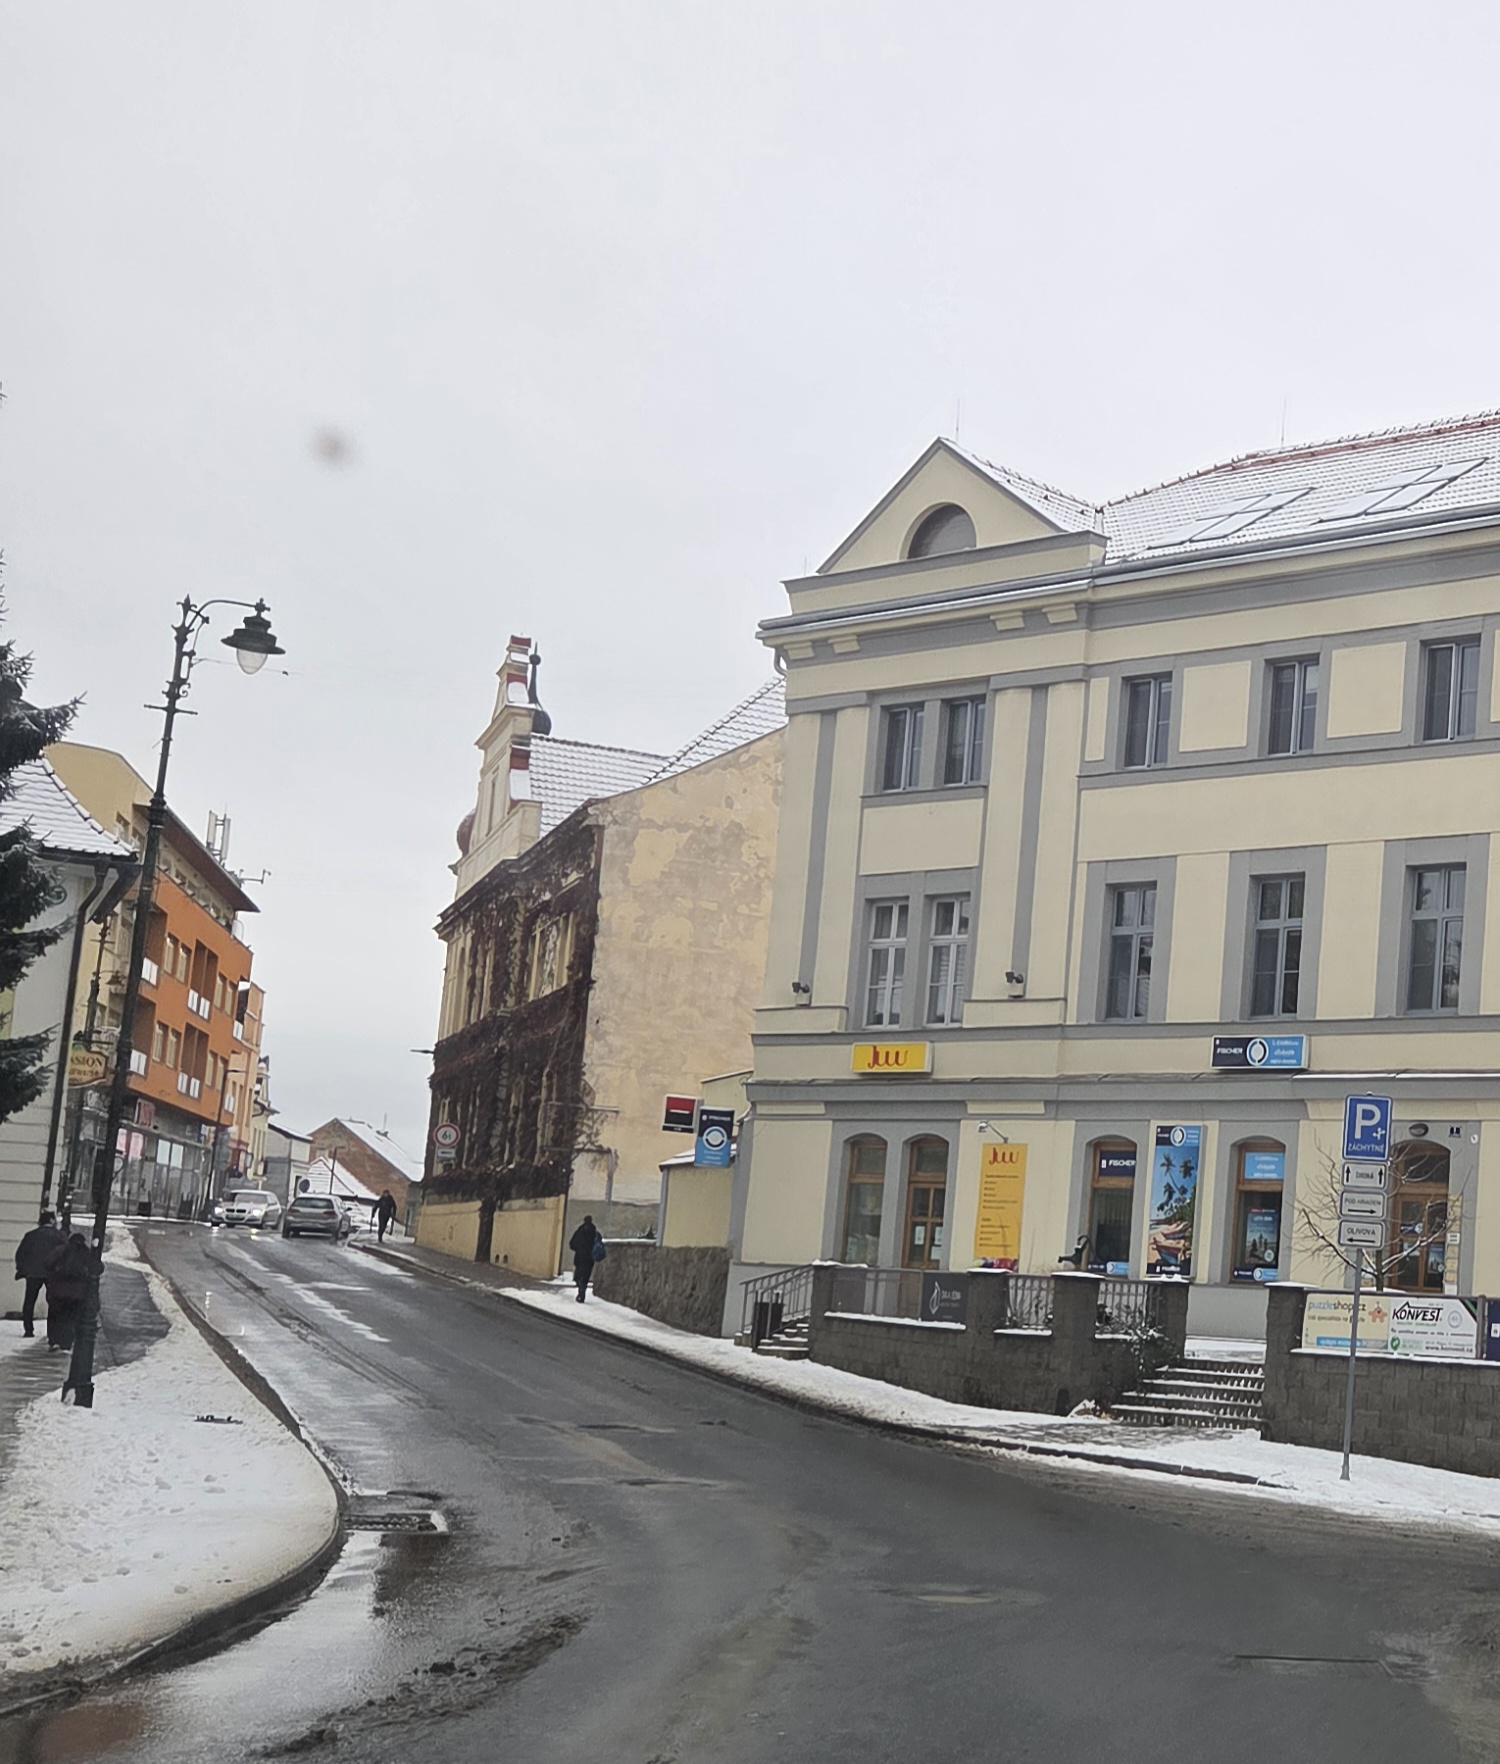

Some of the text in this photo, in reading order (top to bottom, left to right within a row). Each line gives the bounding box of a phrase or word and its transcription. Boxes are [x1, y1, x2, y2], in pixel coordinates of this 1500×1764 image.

[1355, 1103, 1381, 1139] P
[1346, 1226, 1376, 1236] OLIVOVA
[1392, 1301, 1444, 1322] KONVEST
